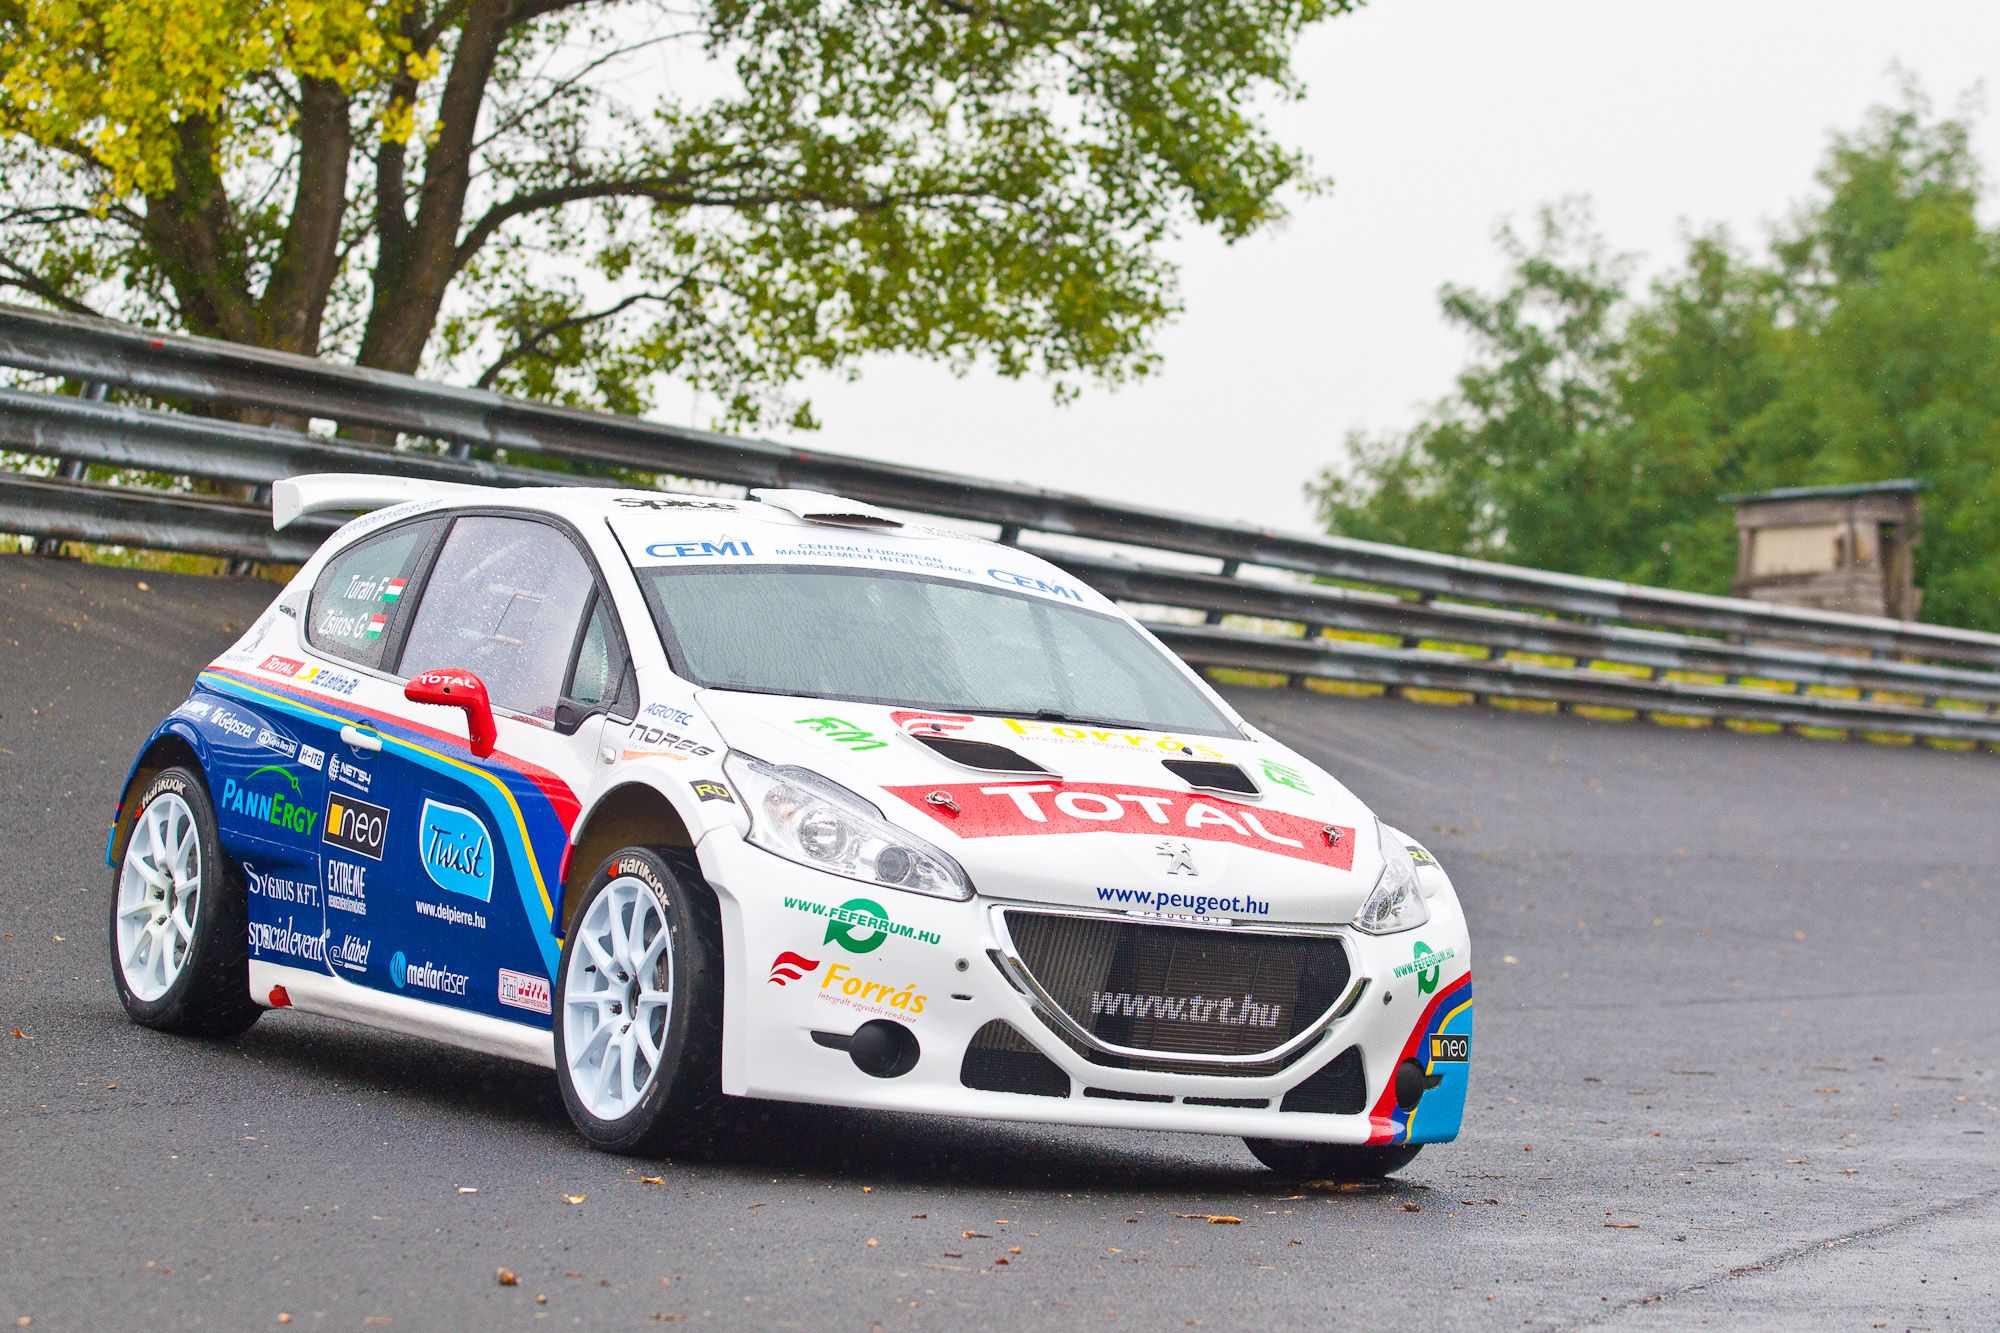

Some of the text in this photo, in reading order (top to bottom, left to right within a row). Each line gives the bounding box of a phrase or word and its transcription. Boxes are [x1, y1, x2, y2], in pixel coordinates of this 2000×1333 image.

[646, 541, 755, 558] CEMI
[775, 549, 975, 575] MANAGEMENT INTELLIGENCE
[798, 543, 942, 563] CENTRAL EUROPEAN
[343, 574, 390, 601] Turán F.
[987, 568, 1084, 602] CEMI
[353, 612, 369, 639] G.
[264, 656, 295, 674] TOTAL
[420, 674, 475, 689] TOTAL
[219, 712, 256, 739] Gépszer
[643, 702, 694, 726] AGROTEC
[301, 748, 323, 766] H-ITB
[695, 783, 730, 798] RD
[340, 808, 382, 847] neo
[979, 784, 1305, 849] TOTAL
[428, 824, 485, 878] Twist
[328, 859, 366, 898] EXTREME
[1096, 887, 1269, 915] www.peugeot.hu
[415, 901, 486, 929] www.delpierre.hu
[784, 896, 941, 945] WWW.FEFERRUM.HU
[1393, 947, 1455, 979] WWW.FEFERRUM.HU
[406, 961, 469, 996] meliorlaser
[502, 976, 517, 999] Fini
[821, 963, 928, 1014] Forrás
[818, 991, 851, 1008] Integrált
[885, 1010, 917, 1024] rendszer
[1091, 991, 1281, 1027] www.trt.hu
[1441, 1039, 1467, 1057] neo
